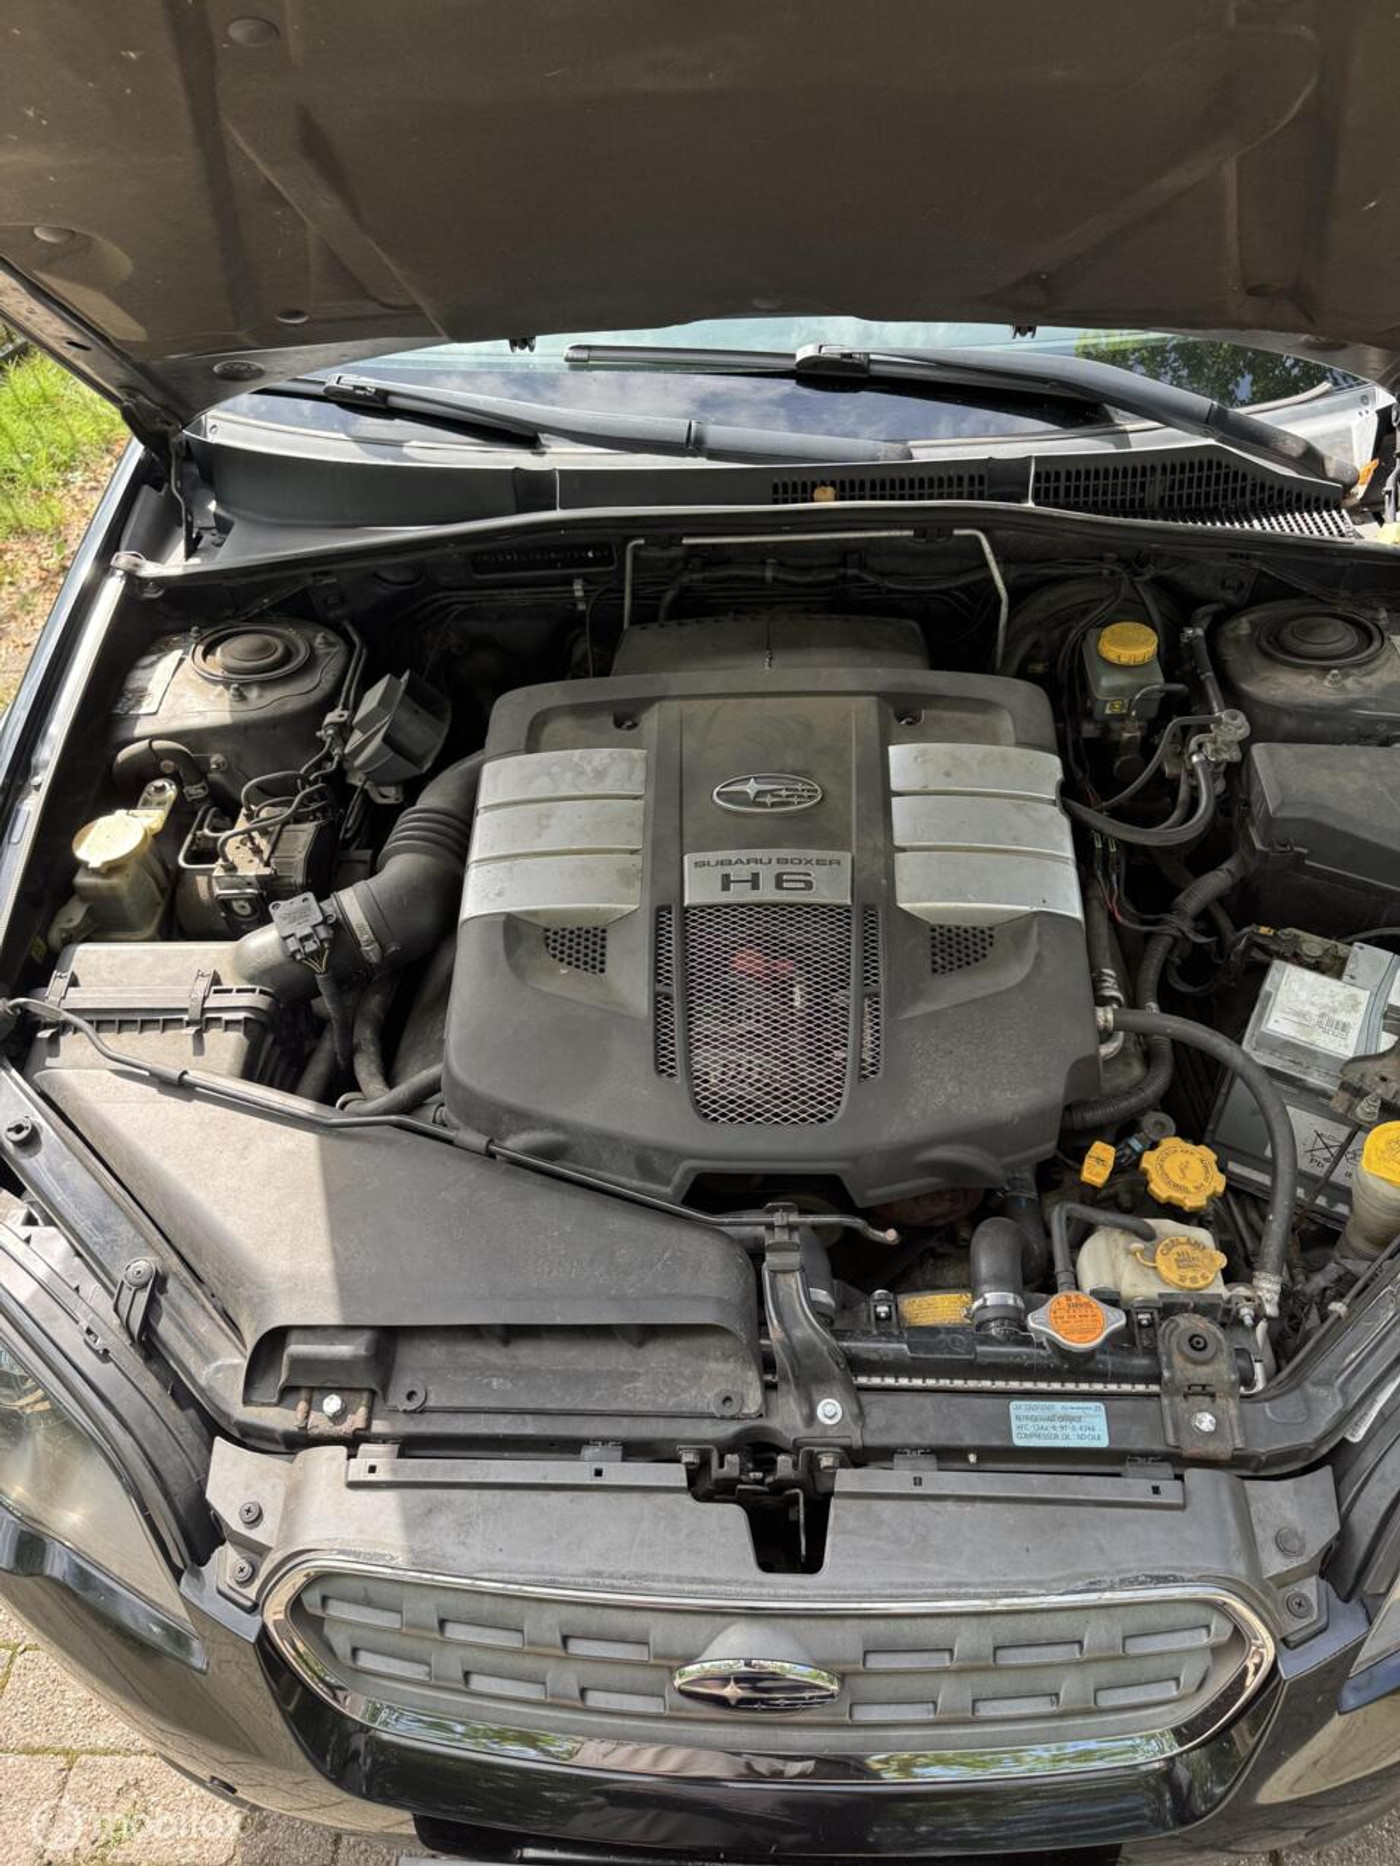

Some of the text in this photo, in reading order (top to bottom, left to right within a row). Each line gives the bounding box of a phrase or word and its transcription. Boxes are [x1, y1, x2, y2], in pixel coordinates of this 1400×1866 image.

[693, 857, 842, 868] SUBARU BOXER
[721, 872, 814, 892] H6
